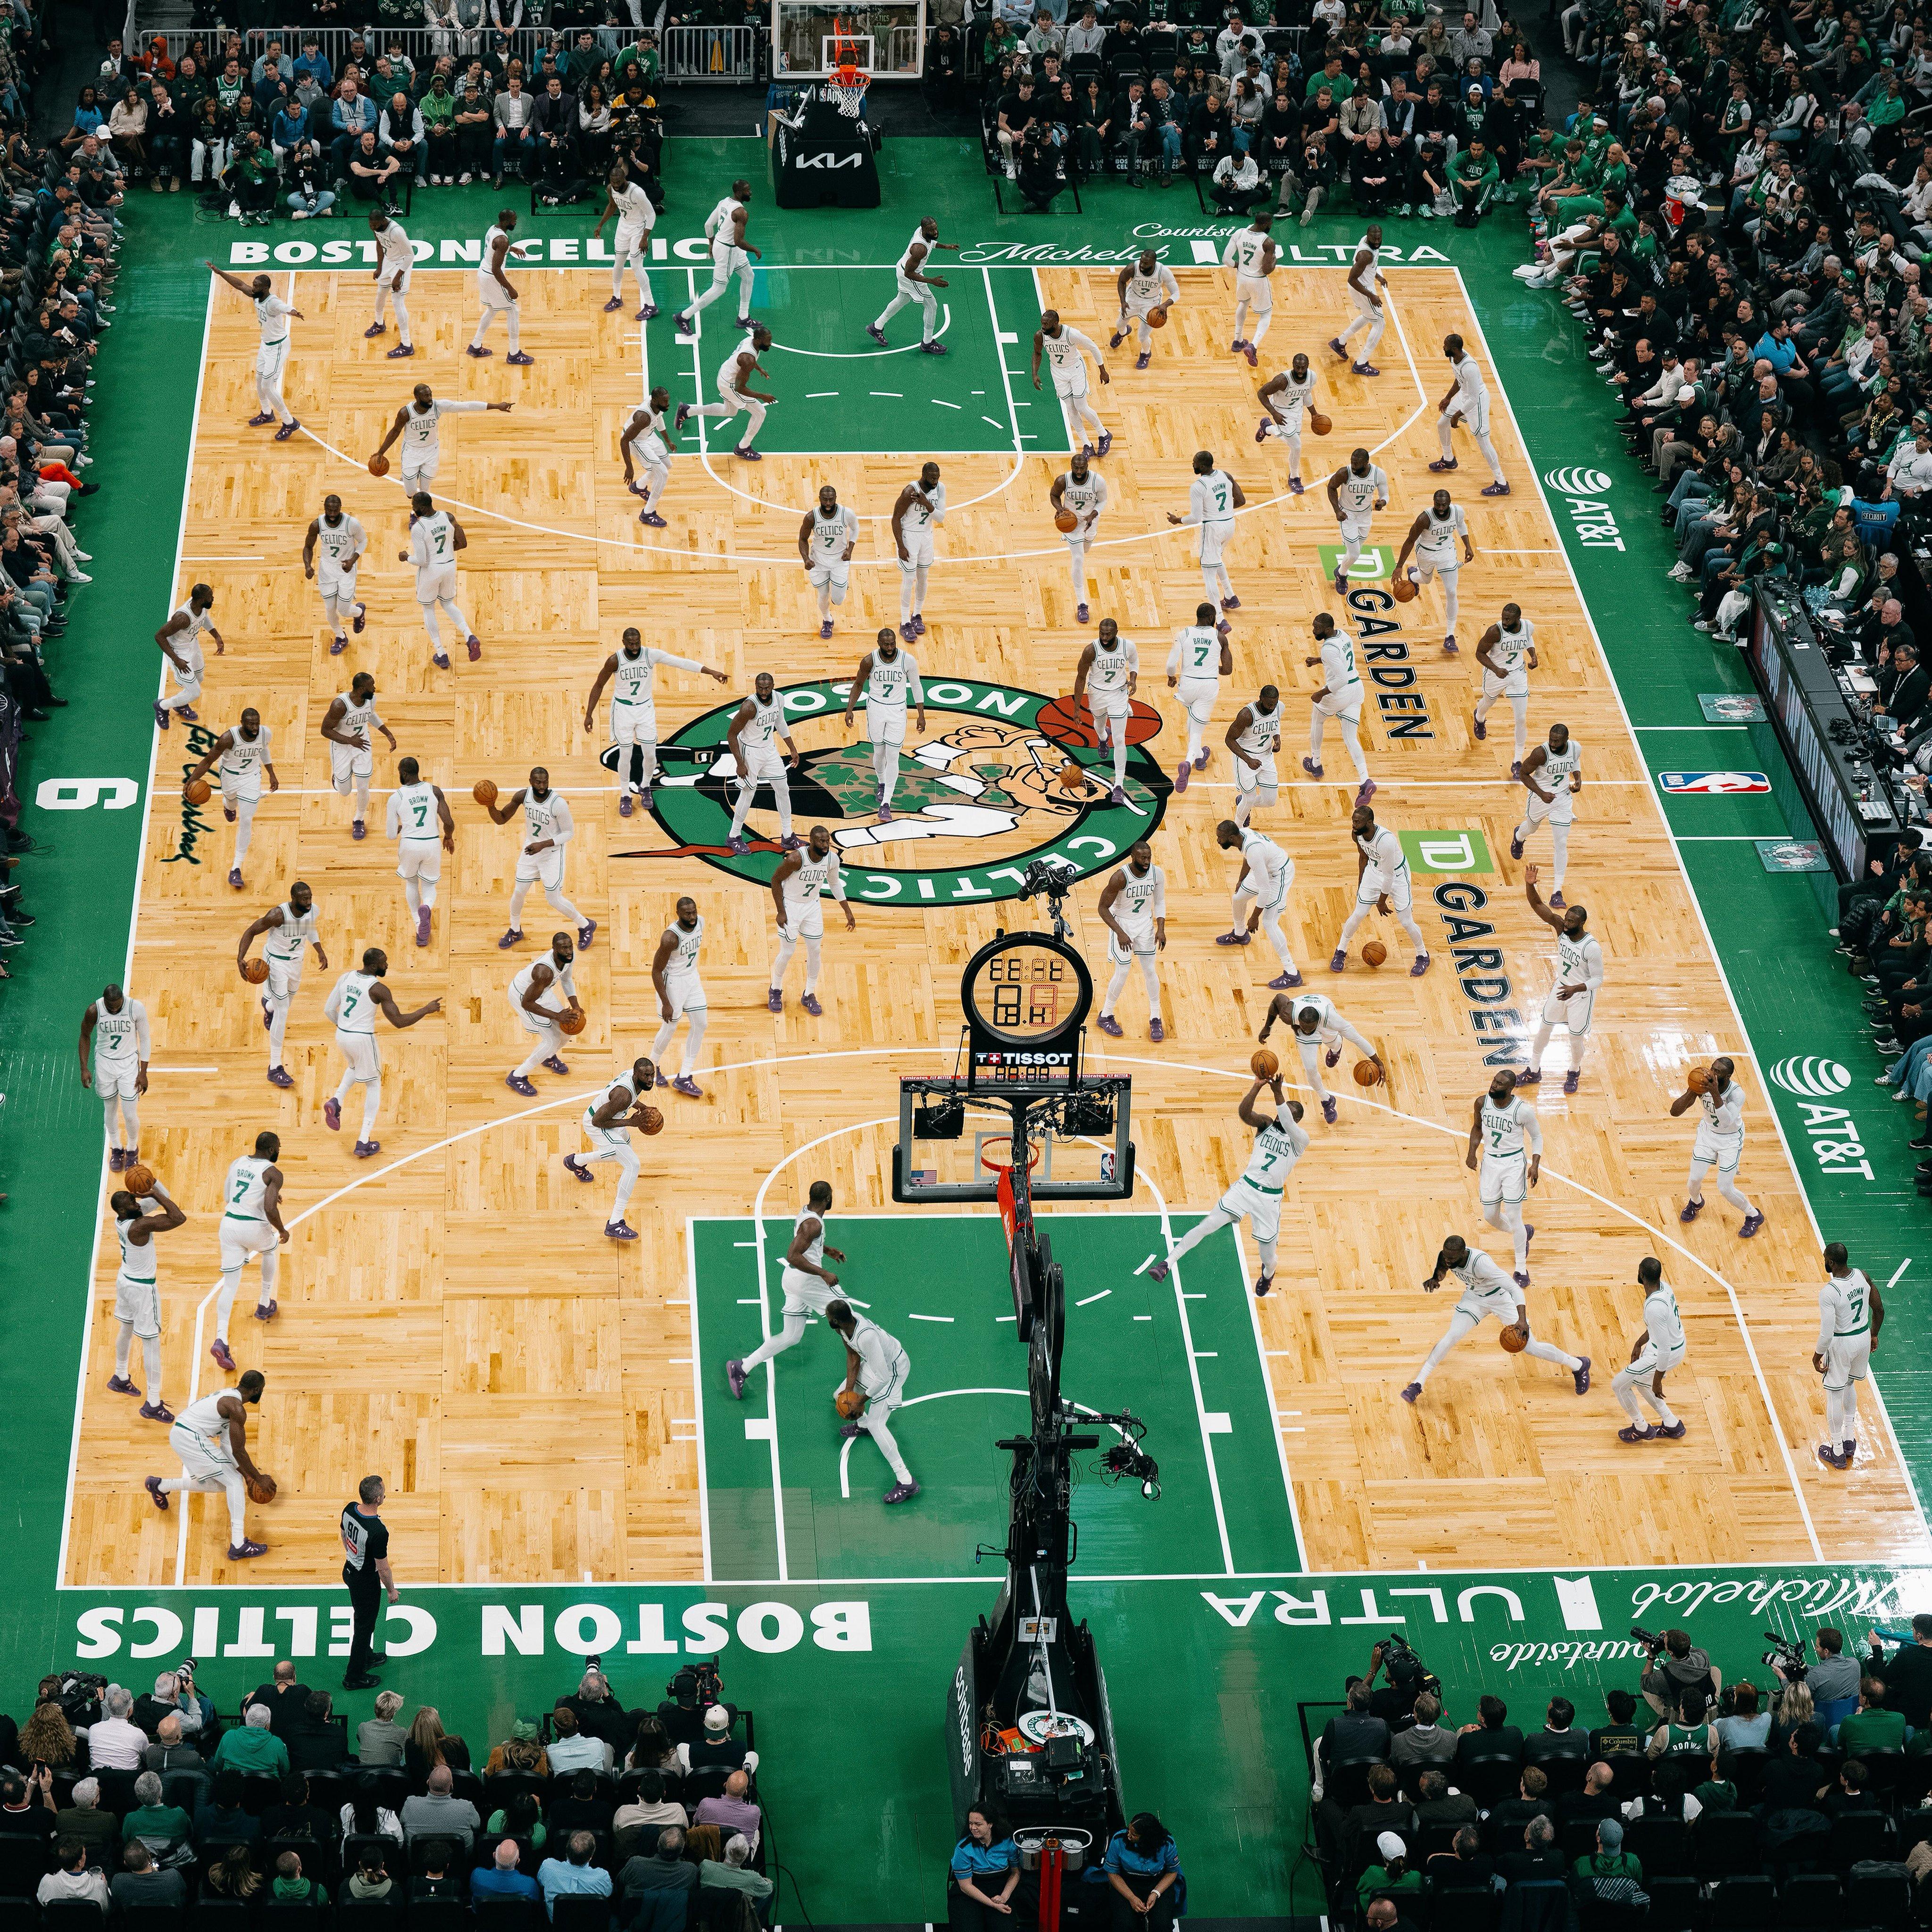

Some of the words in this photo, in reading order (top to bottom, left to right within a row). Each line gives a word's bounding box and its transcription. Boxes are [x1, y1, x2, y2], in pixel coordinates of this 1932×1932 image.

[531, 13, 541, 25] 0
[796, 153, 862, 168] KIA
[299, 169, 304, 178] 3
[1466, 165, 1482, 176] CELTICS
[621, 208, 627, 220] 7
[1242, 241, 1257, 251] BROWN
[1243, 250, 1255, 266] 7
[1133, 278, 1158, 289] CELTICS
[1140, 287, 1150, 296] 7
[1045, 342, 1069, 354] CELTICS
[1055, 354, 1064, 366] 7
[1288, 397, 1299, 406] 7
[410, 419, 436, 430] CELTICS
[419, 432, 429, 441] 7
[1348, 483, 1374, 494] CELTICS
[1075, 501, 1084, 510] 7
[1215, 491, 1227, 511] 7
[1355, 495, 1366, 505] 7
[919, 513, 929, 525] 7
[1565, 498, 1626, 551] AT&T
[431, 525, 447, 536] BROWN
[816, 525, 843, 536] CELTICS
[321, 534, 347, 545] CELTICS
[434, 534, 446, 552] 7
[824, 537, 834, 547] 7
[1438, 536, 1448, 546] 7
[329, 546, 340, 558] 7
[1193, 638, 1211, 646] BROWN
[1501, 640, 1526, 651] CELTICS
[1194, 648, 1209, 666] 7
[1346, 652, 1353, 672] 7
[1505, 652, 1517, 664] 7
[1097, 659, 1124, 669] CELTICS
[1347, 588, 1436, 740] GARDEN
[620, 668, 647, 681] CELTICS
[874, 671, 902, 682] CELTICS
[1104, 672, 1116, 683] 7
[630, 682, 640, 695] 7
[883, 684, 893, 698] 7
[762, 725, 772, 741] 7
[1257, 734, 1269, 746] 7
[234, 748, 261, 757] CELTICS
[242, 759, 251, 768] 7
[1547, 762, 1573, 774] CELTICS
[1552, 775, 1564, 786] 7
[408, 796, 428, 805] BROWN
[413, 807, 426, 827] 7
[525, 807, 549, 824] CELTICS
[533, 824, 541, 837] 7
[1419, 833, 1475, 869] TD
[1369, 858, 1378, 867] 7
[799, 869, 825, 882] CELTICS
[803, 884, 816, 897] 7
[1126, 885, 1154, 898] CELTICS
[1132, 900, 1145, 912] 7
[290, 939, 301, 951] 7
[686, 953, 696, 967] 7
[1433, 881, 1532, 1066] GARDEN
[1562, 962, 1572, 977] 7
[347, 985, 362, 997] BROWN
[343, 997, 358, 1017] 7
[100, 1021, 130, 1033] CELTICS
[110, 1036, 122, 1049] 7
[1003, 1053, 1072, 1065] TISSOT
[1482, 1115, 1512, 1133] CELTICS
[1710, 1116, 1719, 1127] 7
[1259, 1133, 1289, 1157] CELTICS
[1491, 1132, 1502, 1148] 7
[1797, 1102, 1875, 1181] AT&T
[1261, 1154, 1277, 1172] 7
[237, 1169, 254, 1180] BROWN
[233, 1182, 248, 1203] 7
[1847, 1287, 1864, 1301] BROWN
[1851, 1299, 1863, 1323] 7
[347, 1521, 359, 1545] 90
[1200, 1586, 1525, 1626] ULTRA
[482, 1601, 873, 1657] BOSTON
[1040, 1622, 1048, 1666] CELTICS
[956, 1666, 973, 1777] coinbase
